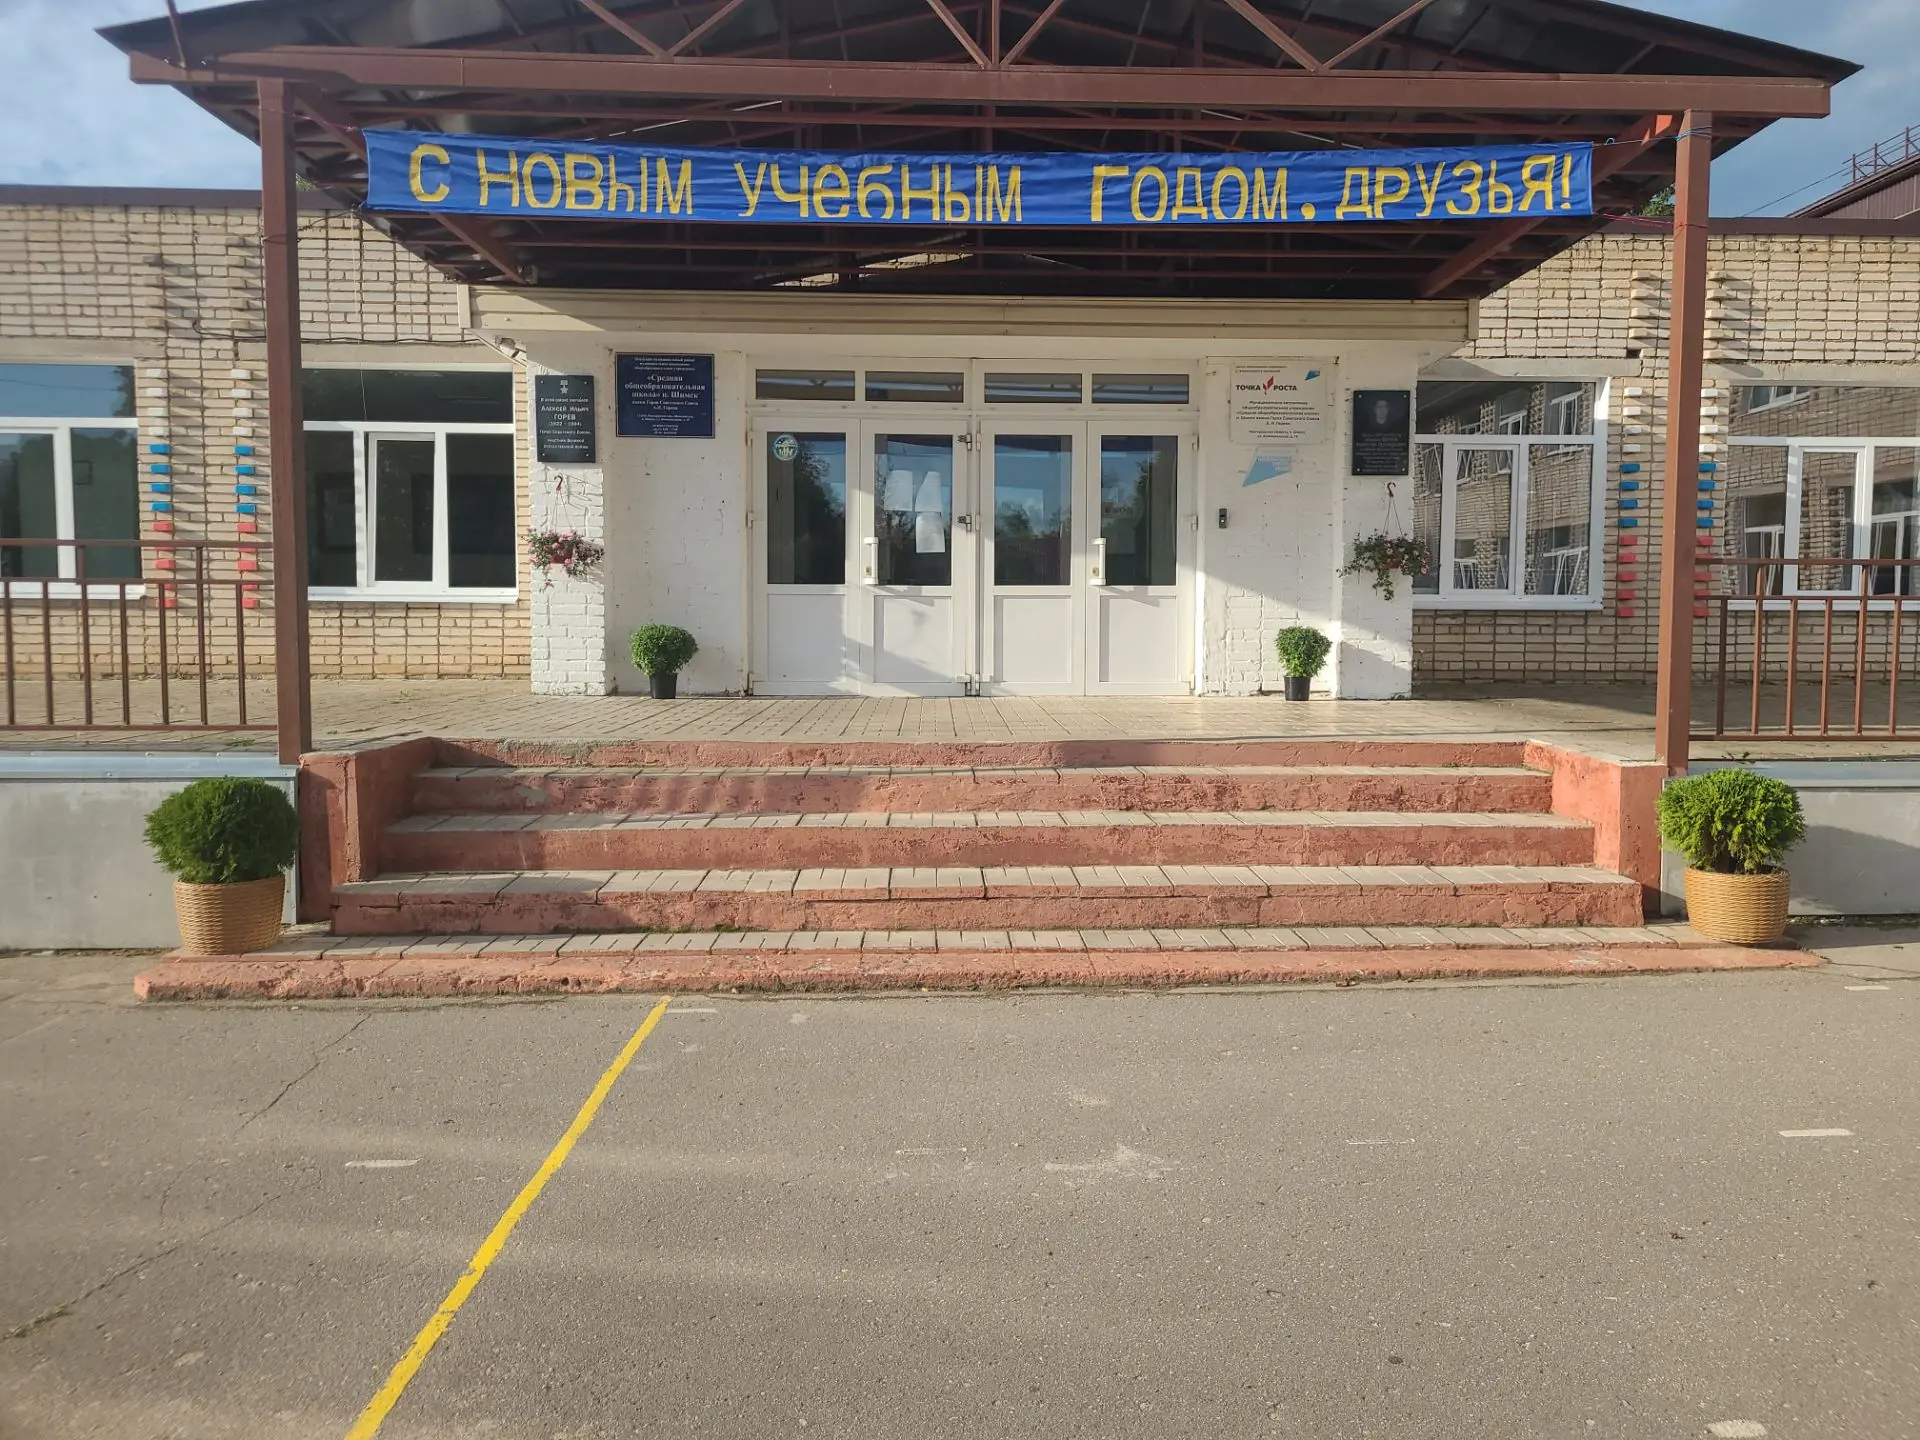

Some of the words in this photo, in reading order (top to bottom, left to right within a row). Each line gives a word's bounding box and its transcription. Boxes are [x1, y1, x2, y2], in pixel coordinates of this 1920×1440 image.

[408, 143, 450, 203] С
[475, 147, 693, 215] НОВЫМ
[1335, 152, 1572, 220] ДРУЗЬЯ!
